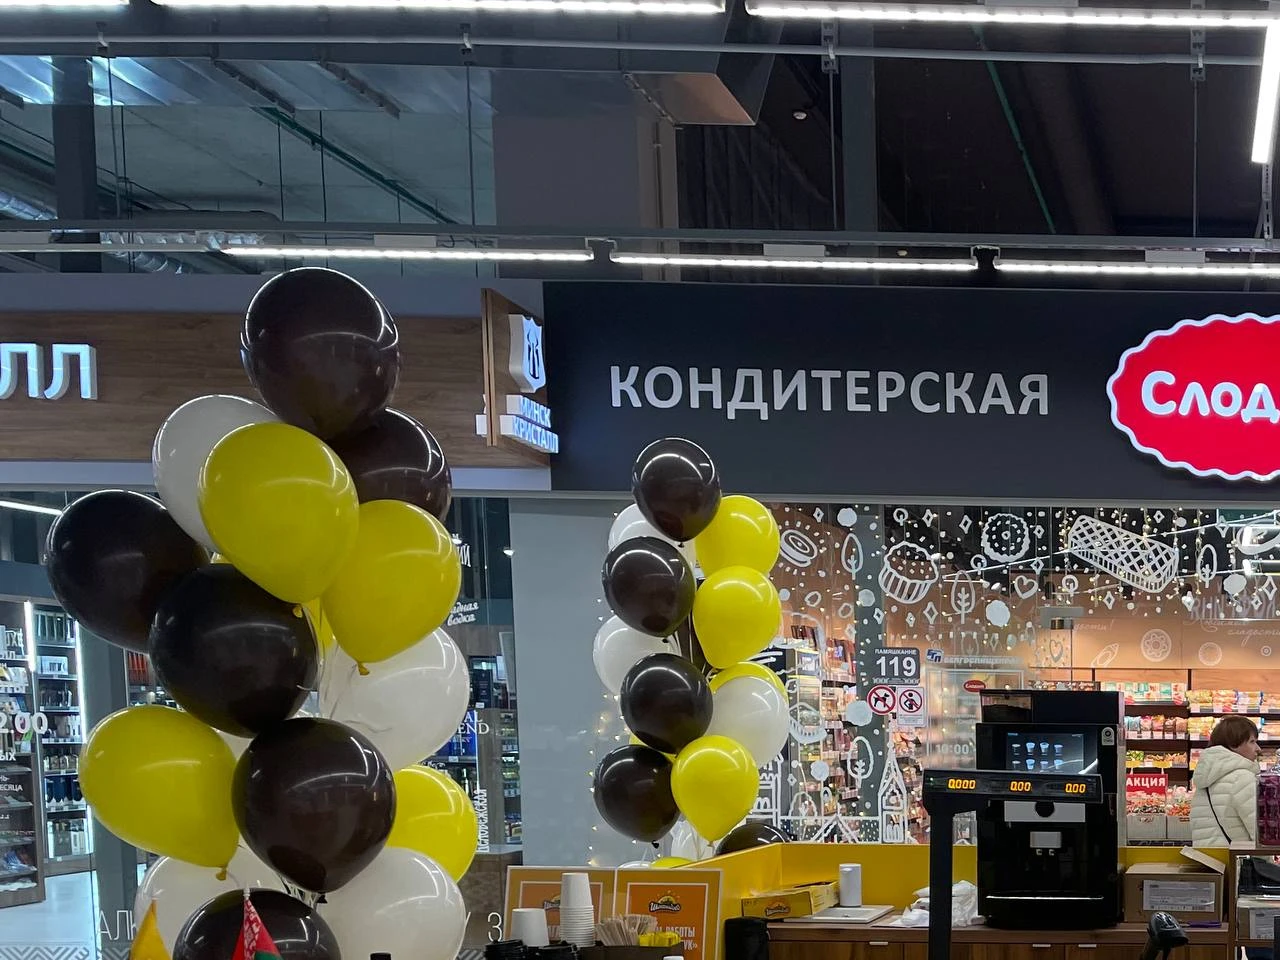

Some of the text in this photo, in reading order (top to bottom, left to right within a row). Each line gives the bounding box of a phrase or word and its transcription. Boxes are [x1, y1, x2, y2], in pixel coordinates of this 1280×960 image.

[609, 364, 1050, 421] КОНДИТЕРСКАЯ
[520, 396, 551, 428] МИНСК
[512, 415, 559, 454] КРИСТАЛЛ
[876, 656, 917, 677] 119
[1126, 776, 1166, 788] АКЦИЯ
